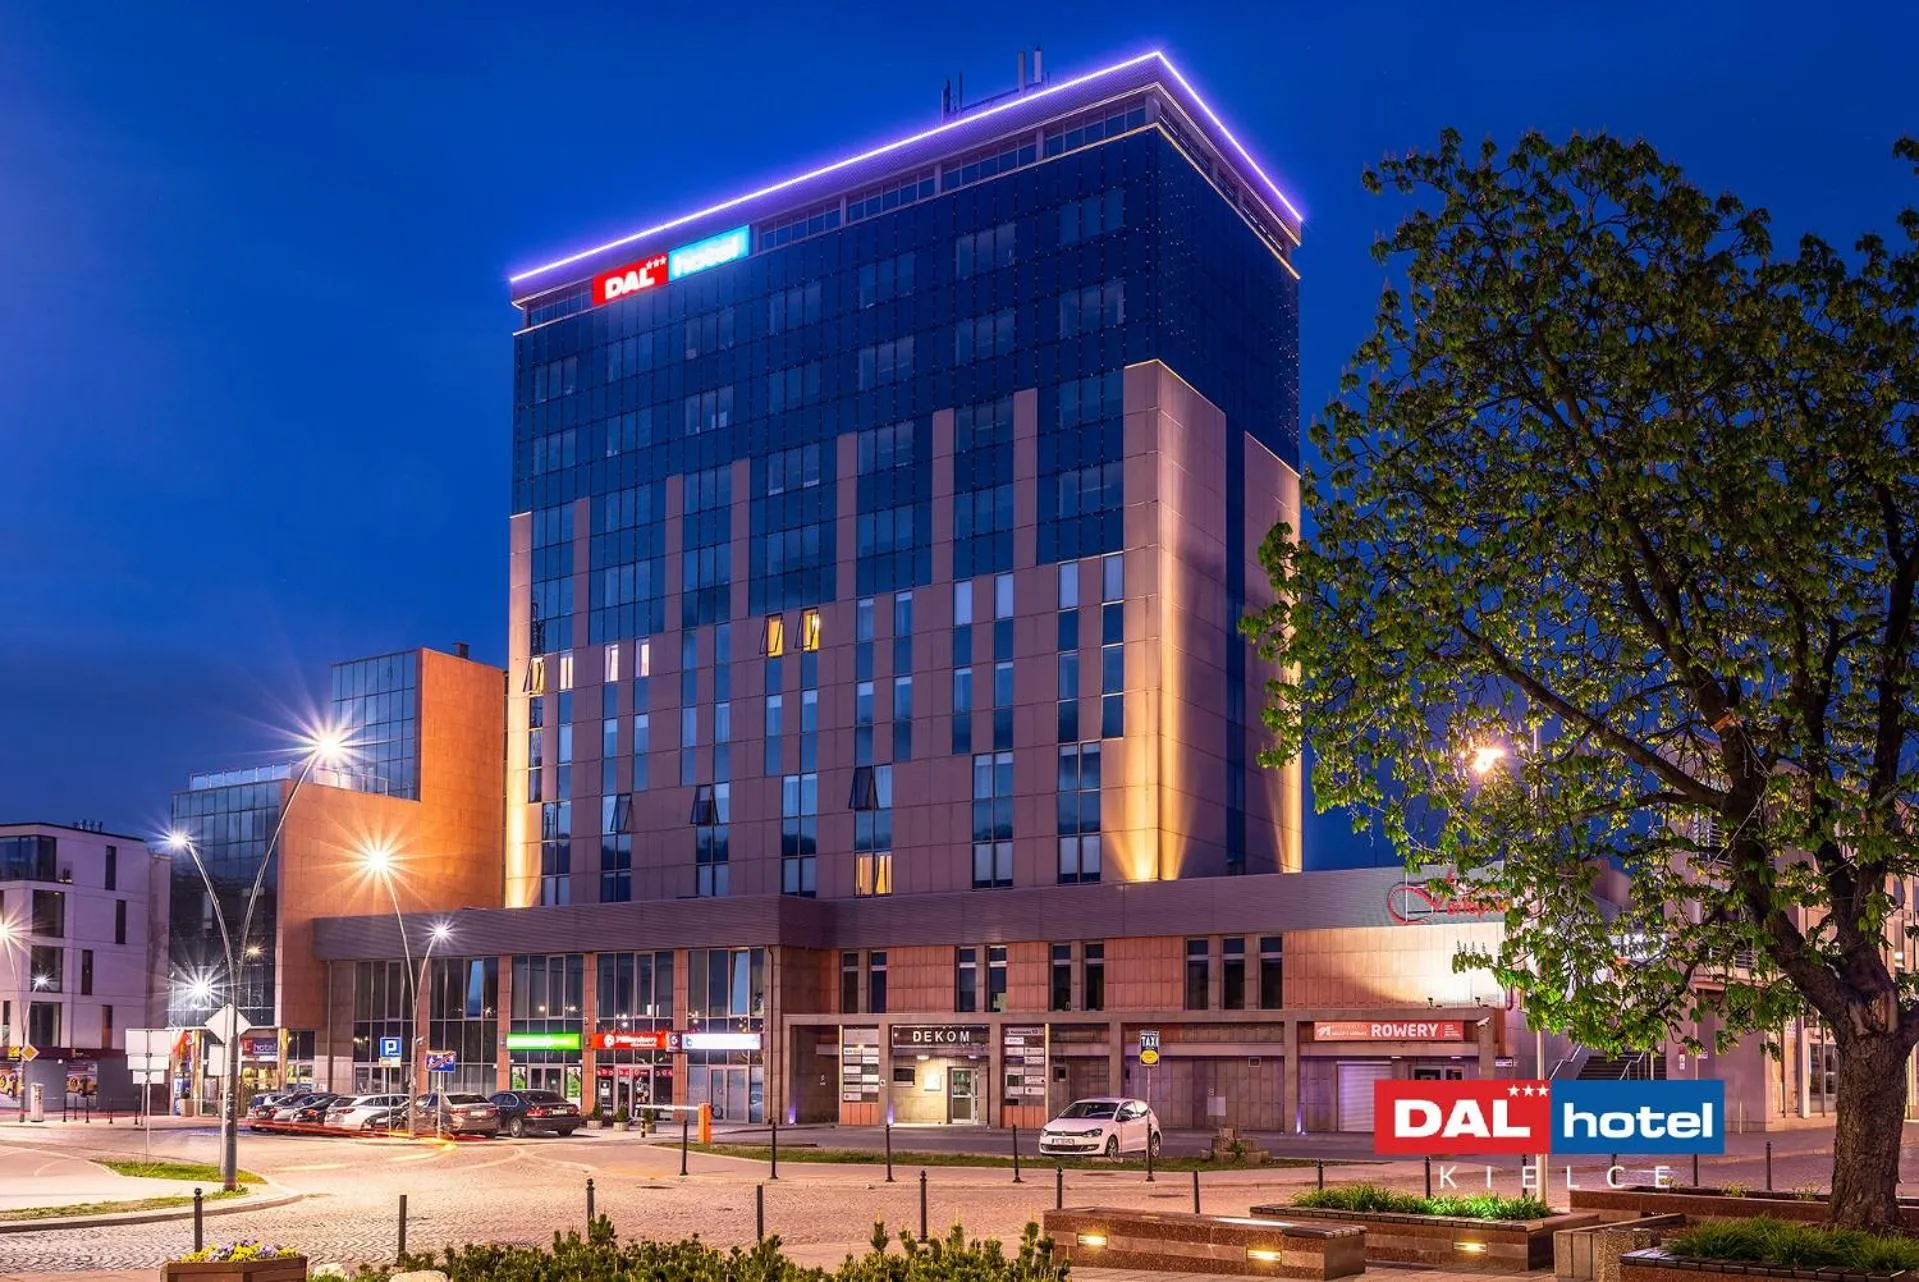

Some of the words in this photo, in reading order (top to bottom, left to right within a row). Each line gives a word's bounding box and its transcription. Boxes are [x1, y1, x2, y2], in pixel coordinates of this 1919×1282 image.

[604, 267, 655, 300] DAL
[912, 1030, 970, 1042] DEKOM
[1370, 1023, 1438, 1037] ROWERY
[384, 1039, 398, 1055] P
[1141, 1035, 1159, 1048] TAXI
